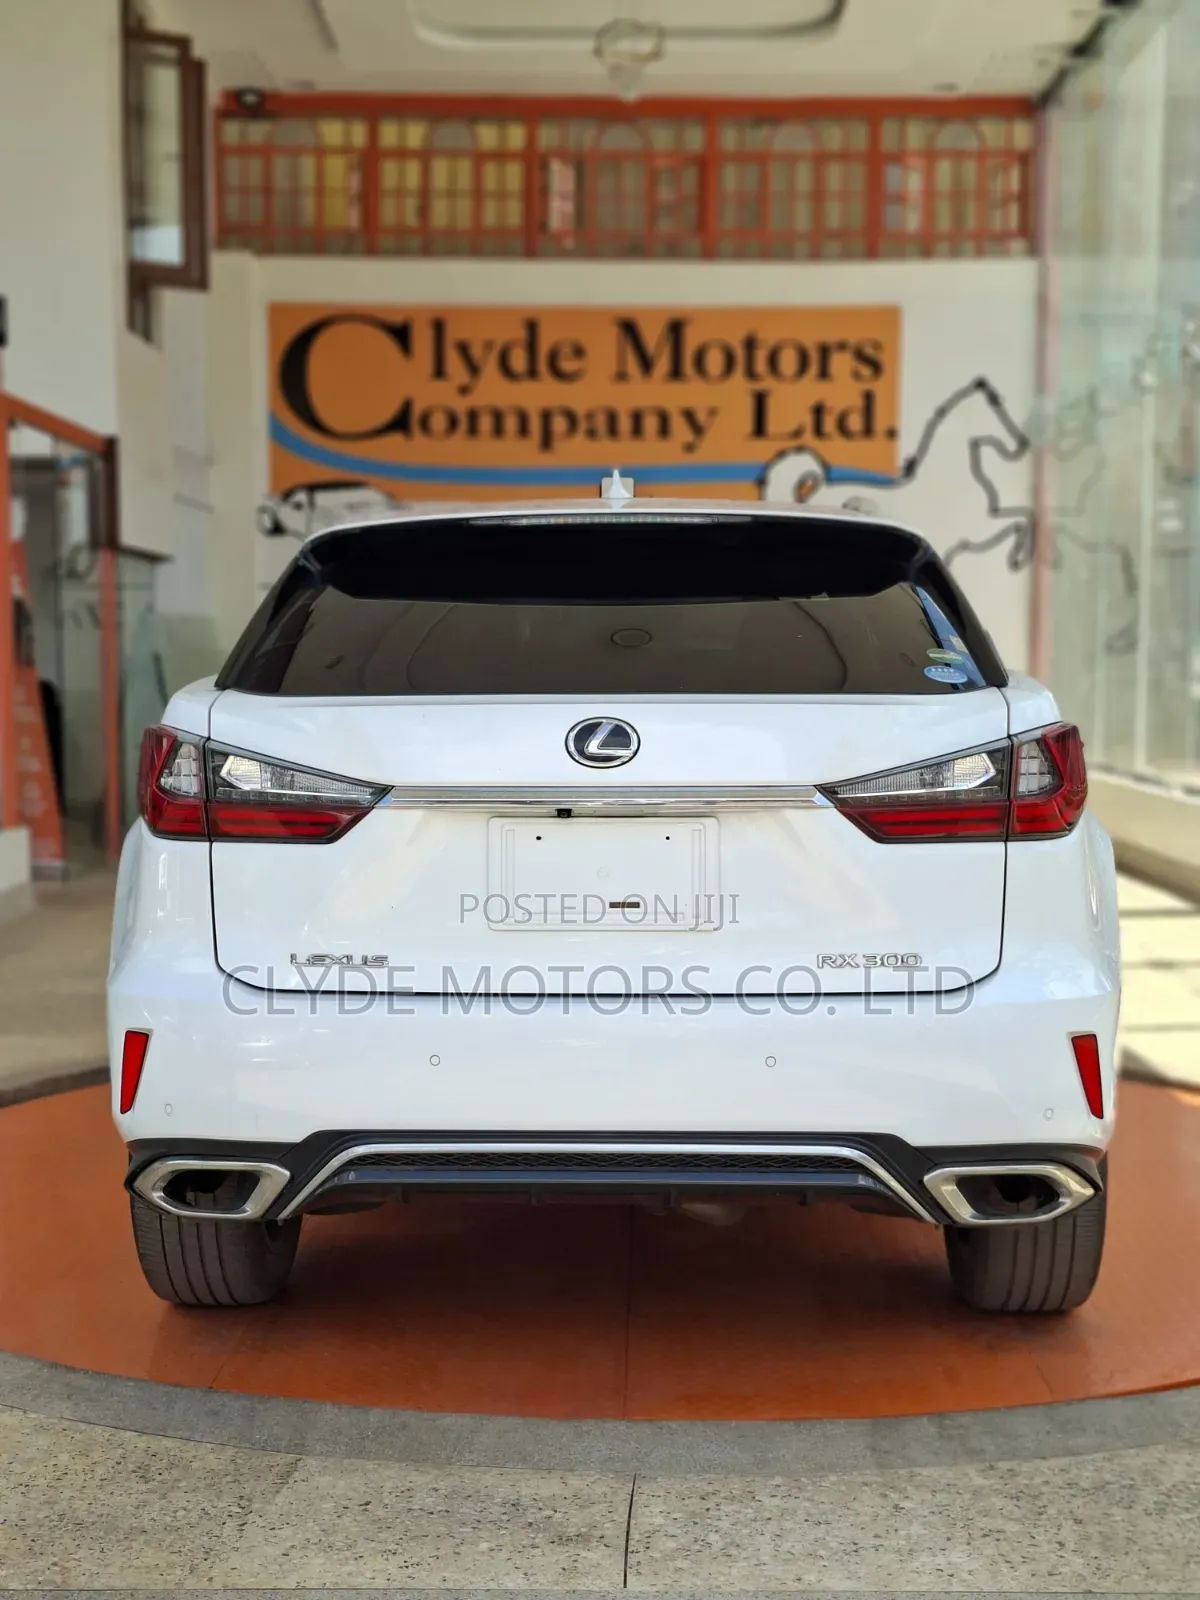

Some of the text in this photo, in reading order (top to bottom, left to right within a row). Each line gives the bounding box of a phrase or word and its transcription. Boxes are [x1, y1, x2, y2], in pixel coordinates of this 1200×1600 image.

[611, 316, 885, 384] Motors
[749, 389, 900, 441] Ltd.
[290, 953, 389, 968] LEXUS
[816, 953, 923, 969] RX 300
